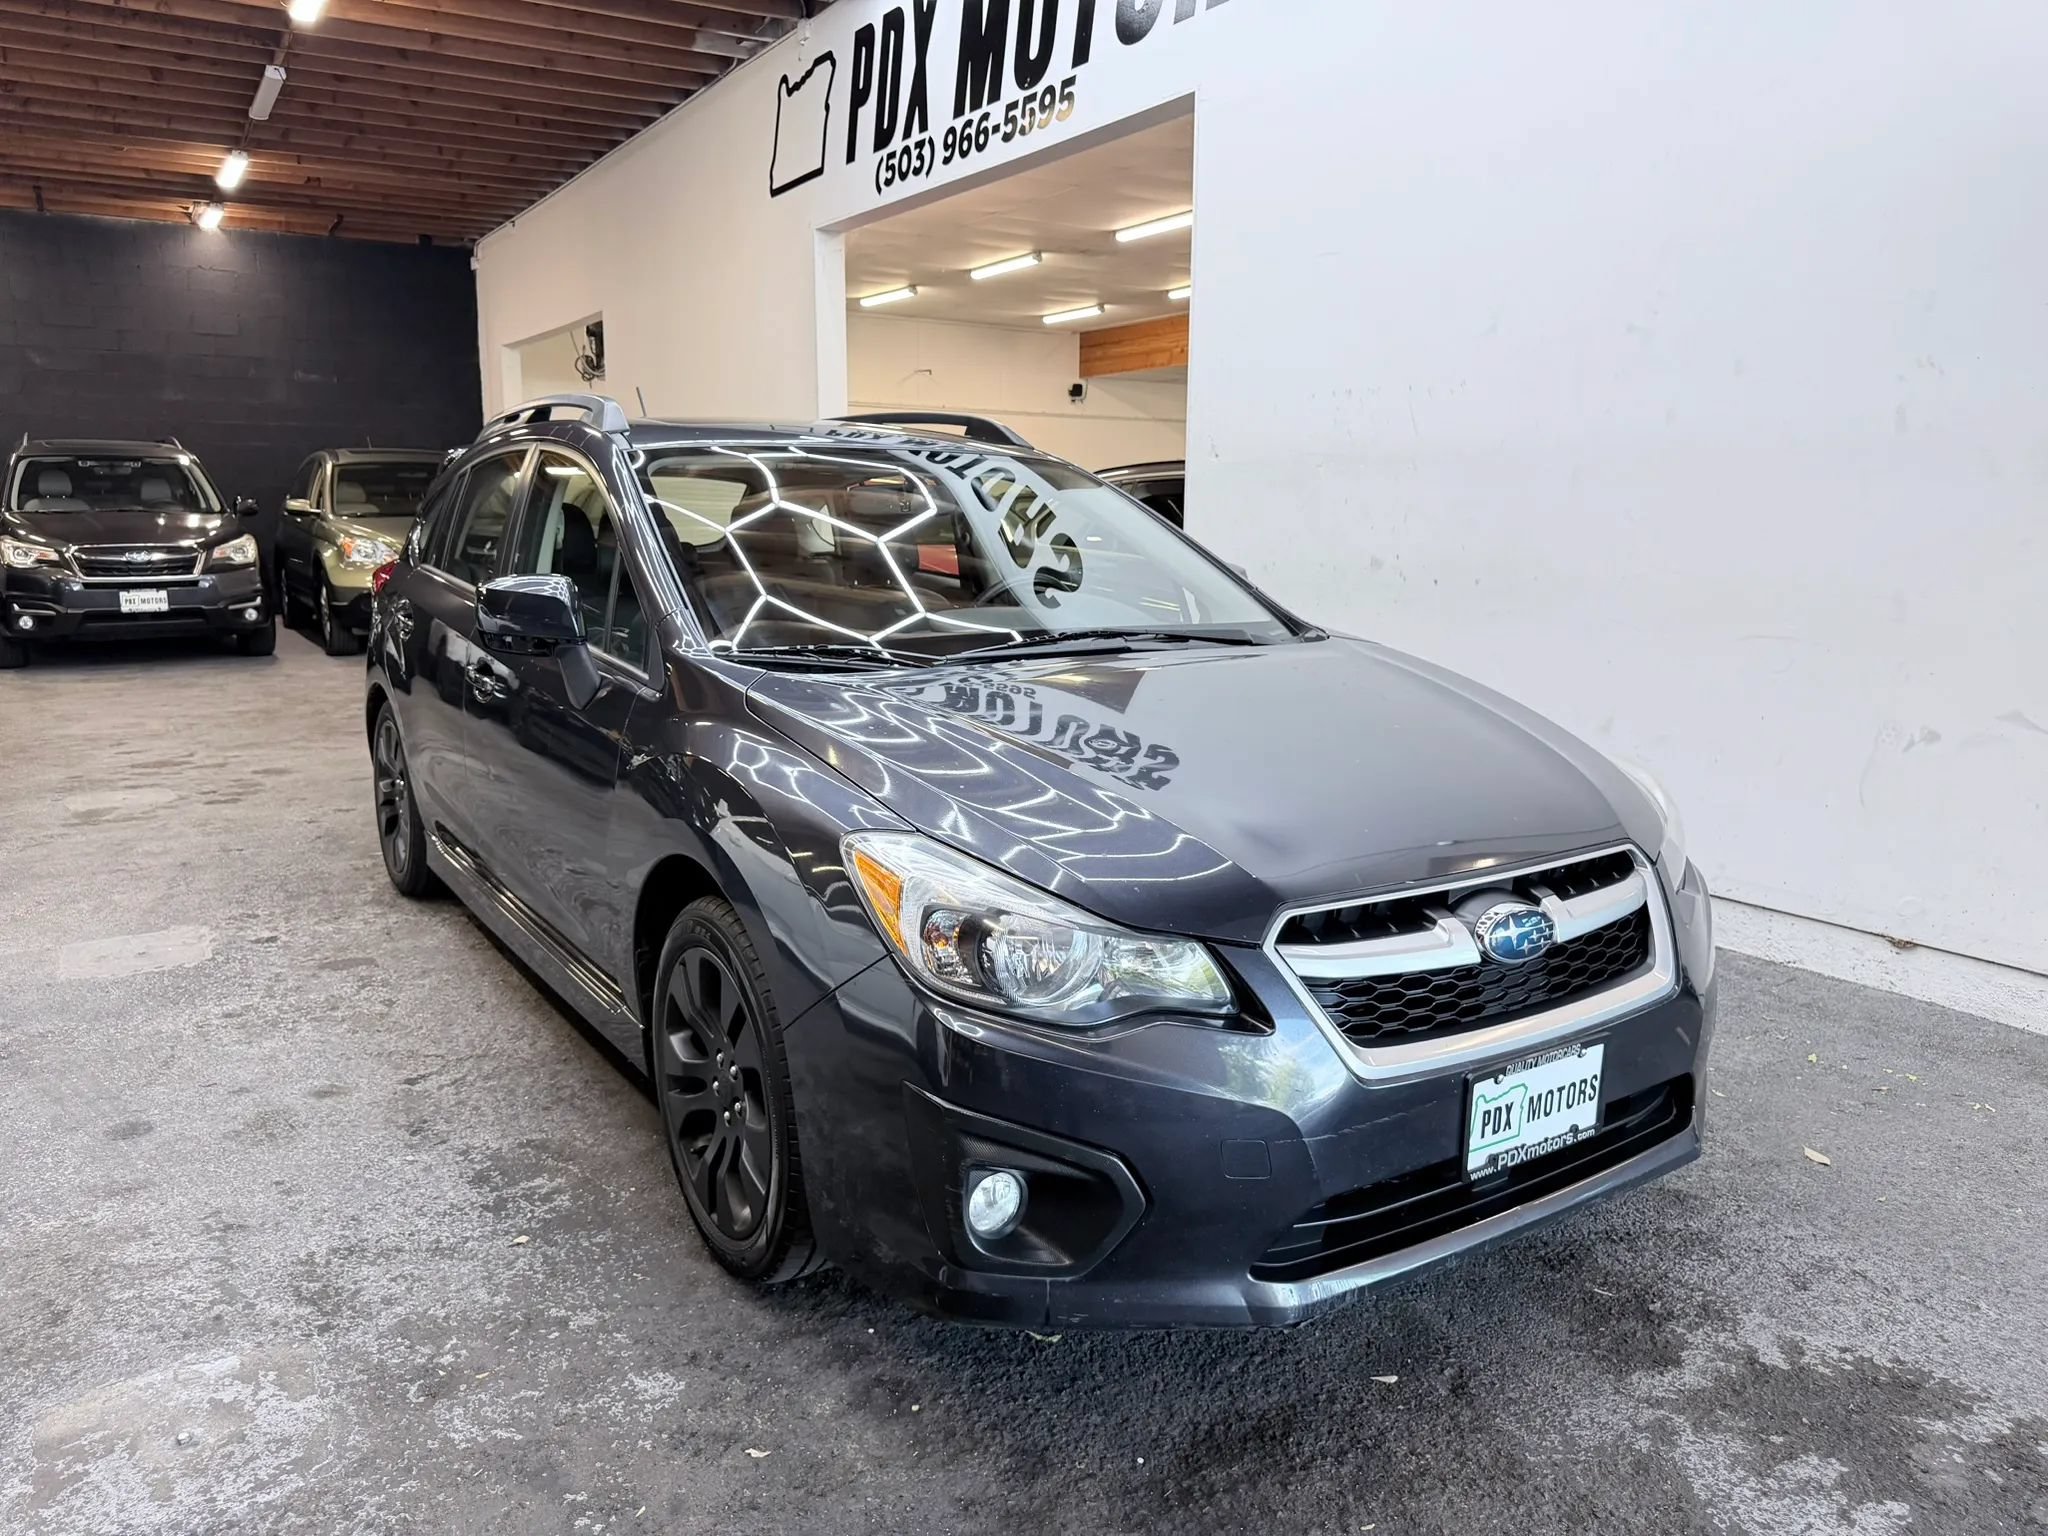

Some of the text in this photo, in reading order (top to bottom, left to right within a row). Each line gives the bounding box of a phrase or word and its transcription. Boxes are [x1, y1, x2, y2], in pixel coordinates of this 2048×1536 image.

[846, 0, 938, 165] PDX
[875, 75, 1077, 195] (503) 966-5595
[1481, 1073, 1598, 1139] PDX MOTORS
[1470, 1128, 1596, 1182] www.PDXmotors.com
